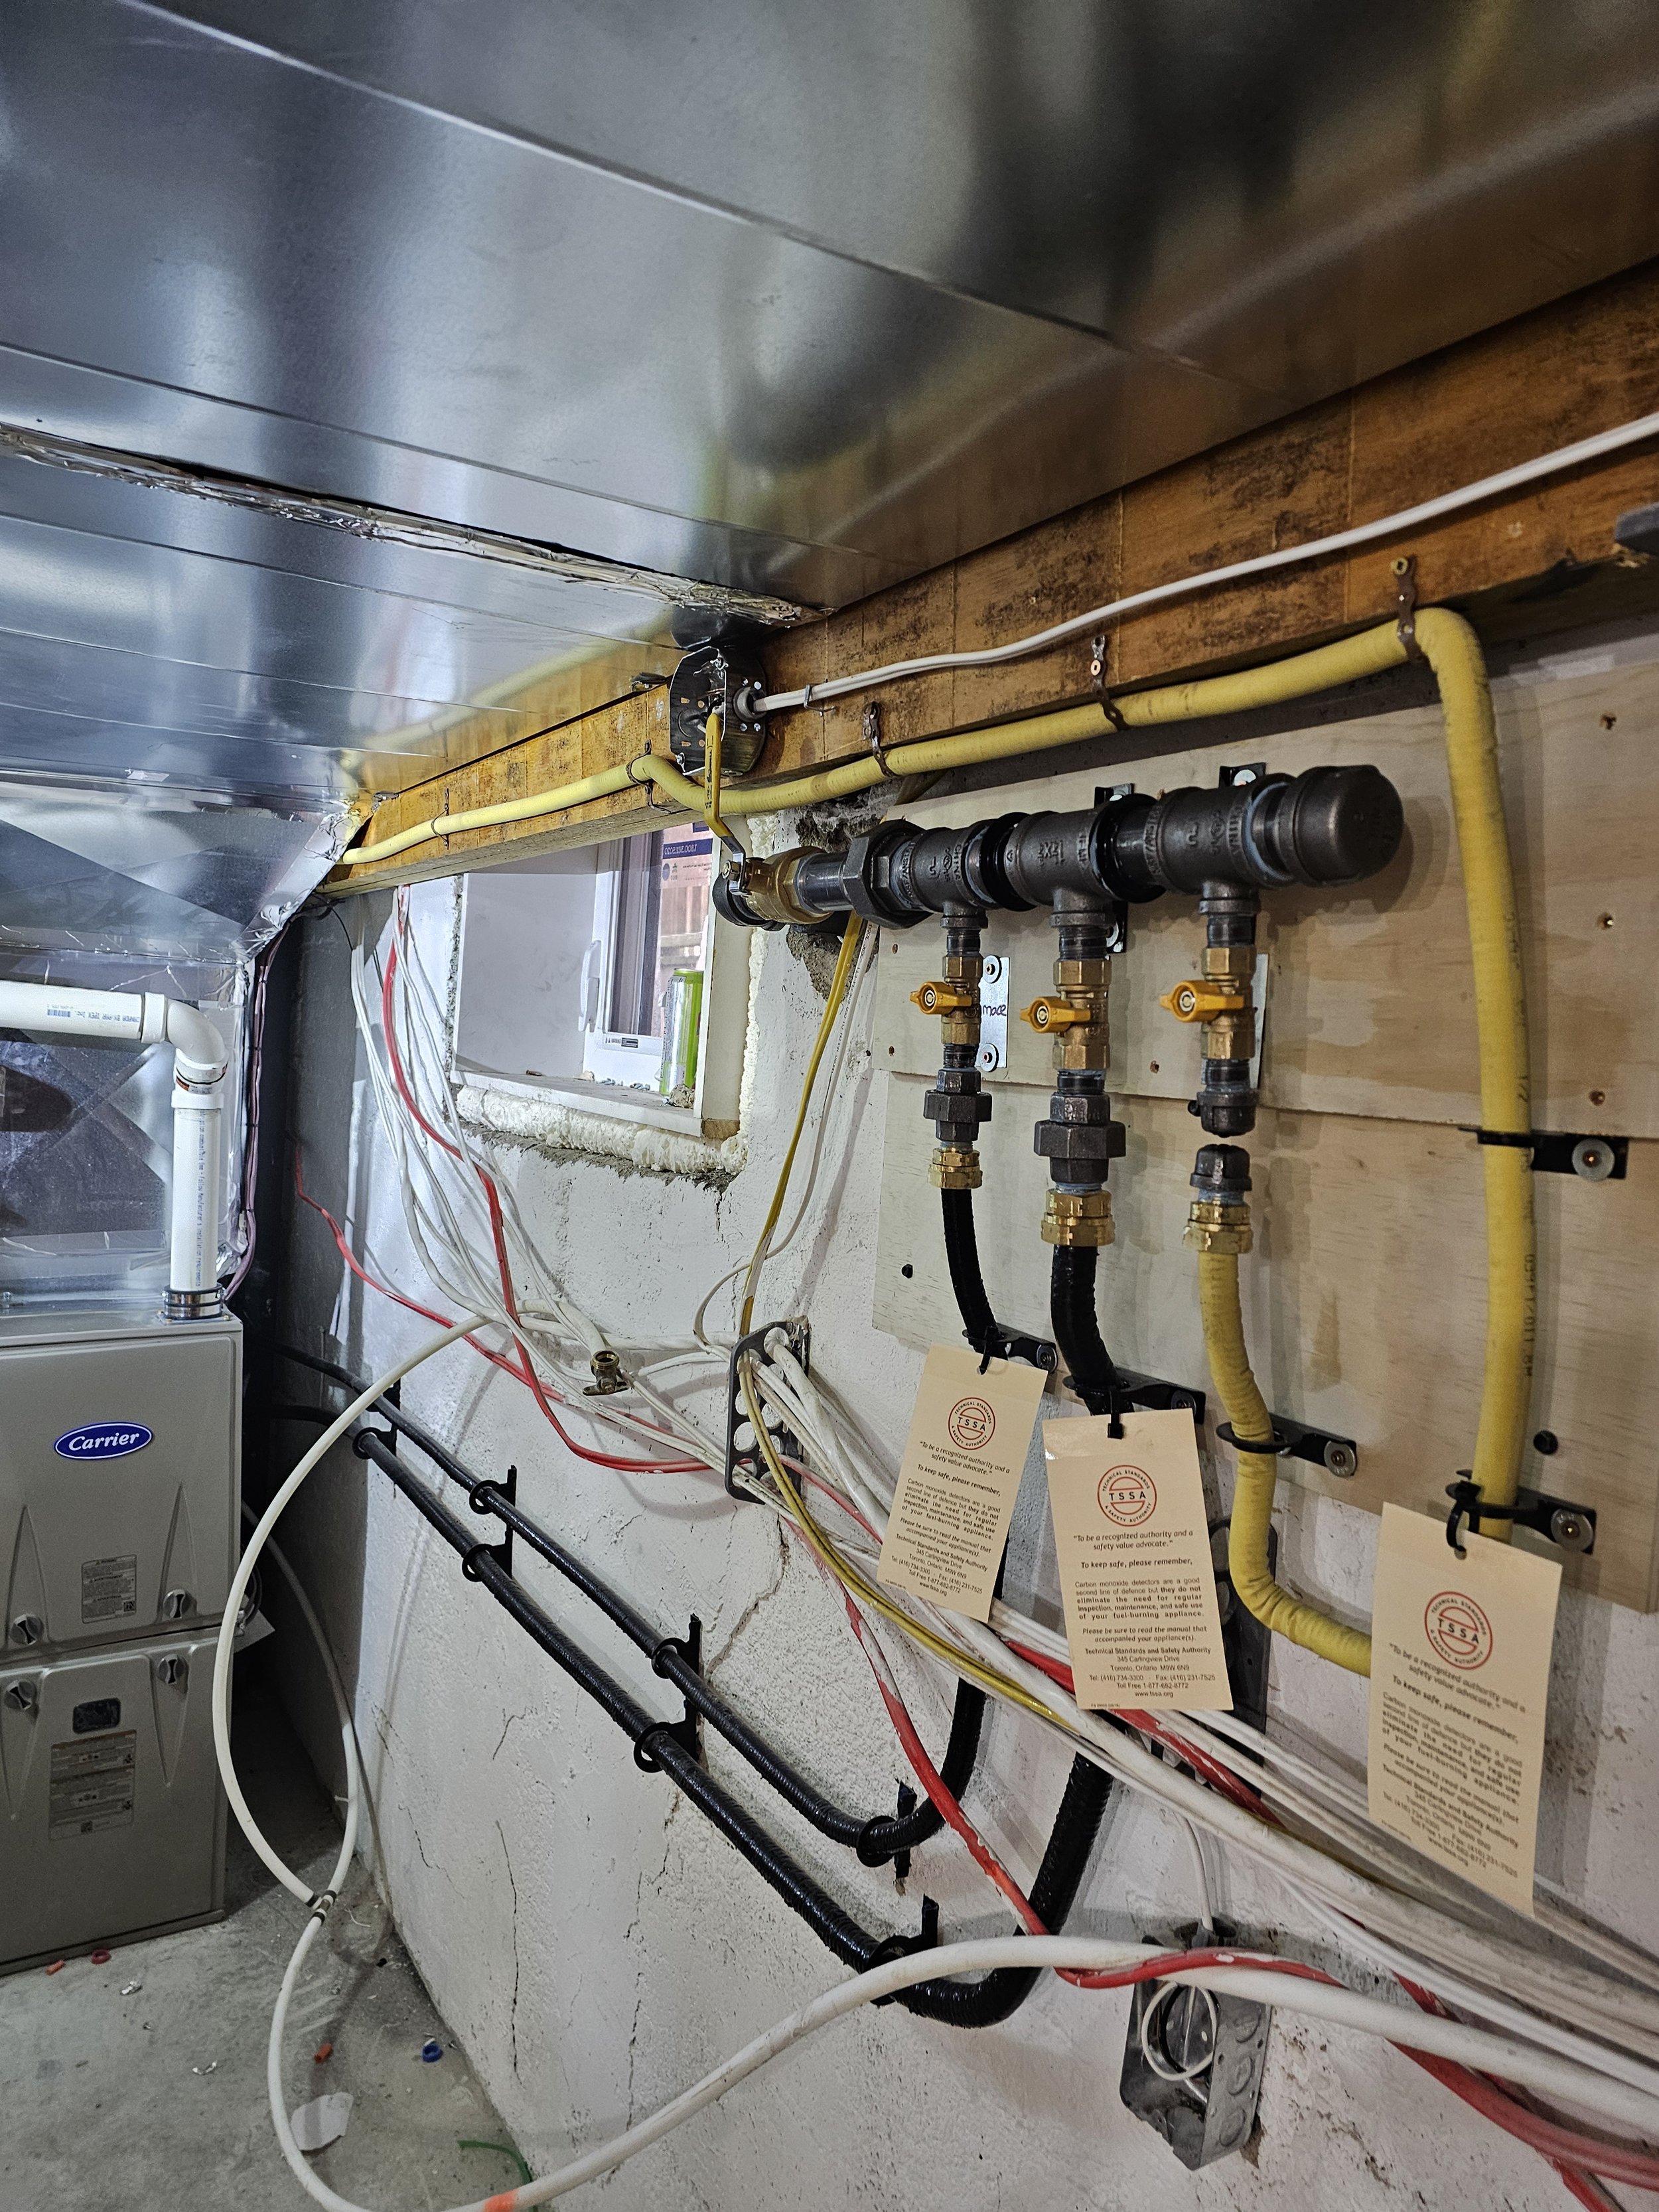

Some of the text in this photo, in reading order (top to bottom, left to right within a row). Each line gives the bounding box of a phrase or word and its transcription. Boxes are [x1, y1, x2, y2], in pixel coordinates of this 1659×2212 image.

[955, 1402, 991, 1424] TECHNICAL STANDARDS
[958, 1416, 985, 1432] TSSA
[68, 1432, 139, 1451] Carrier
[952, 1430, 964, 1444] SAFETY
[966, 1435, 987, 1447] AUTHORITY
[931, 1453, 948, 1463] safety
[948, 1458, 962, 1467] value
[940, 1448, 969, 1461] recognized
[968, 1457, 994, 1470] authority
[924, 1466, 937, 1476] keep
[938, 1471, 951, 1481] safe,
[951, 1476, 970, 1486] please
[970, 1482, 1001, 1497] remember,
[1102, 1469, 1150, 1492] TECHNICAL STANDARDS
[1109, 1491, 1146, 1501] TSSA
[904, 1492, 929, 1504] eliminate
[945, 1506, 960, 1514] need
[975, 1516, 997, 1527] regular
[1108, 1509, 1126, 1522] SAFETY
[1129, 1503, 1151, 1522] AUTHORITY
[1102, 1532, 1138, 1542] recognized
[1139, 1530, 1172, 1539] authority
[1094, 1542, 1114, 1551] safety
[1091, 1561, 1108, 1570] keep
[1110, 1560, 1127, 1569] safe,
[1128, 1559, 1152, 1568] please
[1154, 1557, 1192, 1566] remember,
[1183, 1577, 1200, 1585] good
[1174, 1593, 1202, 1602] regular
[1165, 1610, 1203, 1619] appliance.
[1437, 1617, 1479, 1645] TSSA
[1182, 1647, 1211, 1655] Authority
